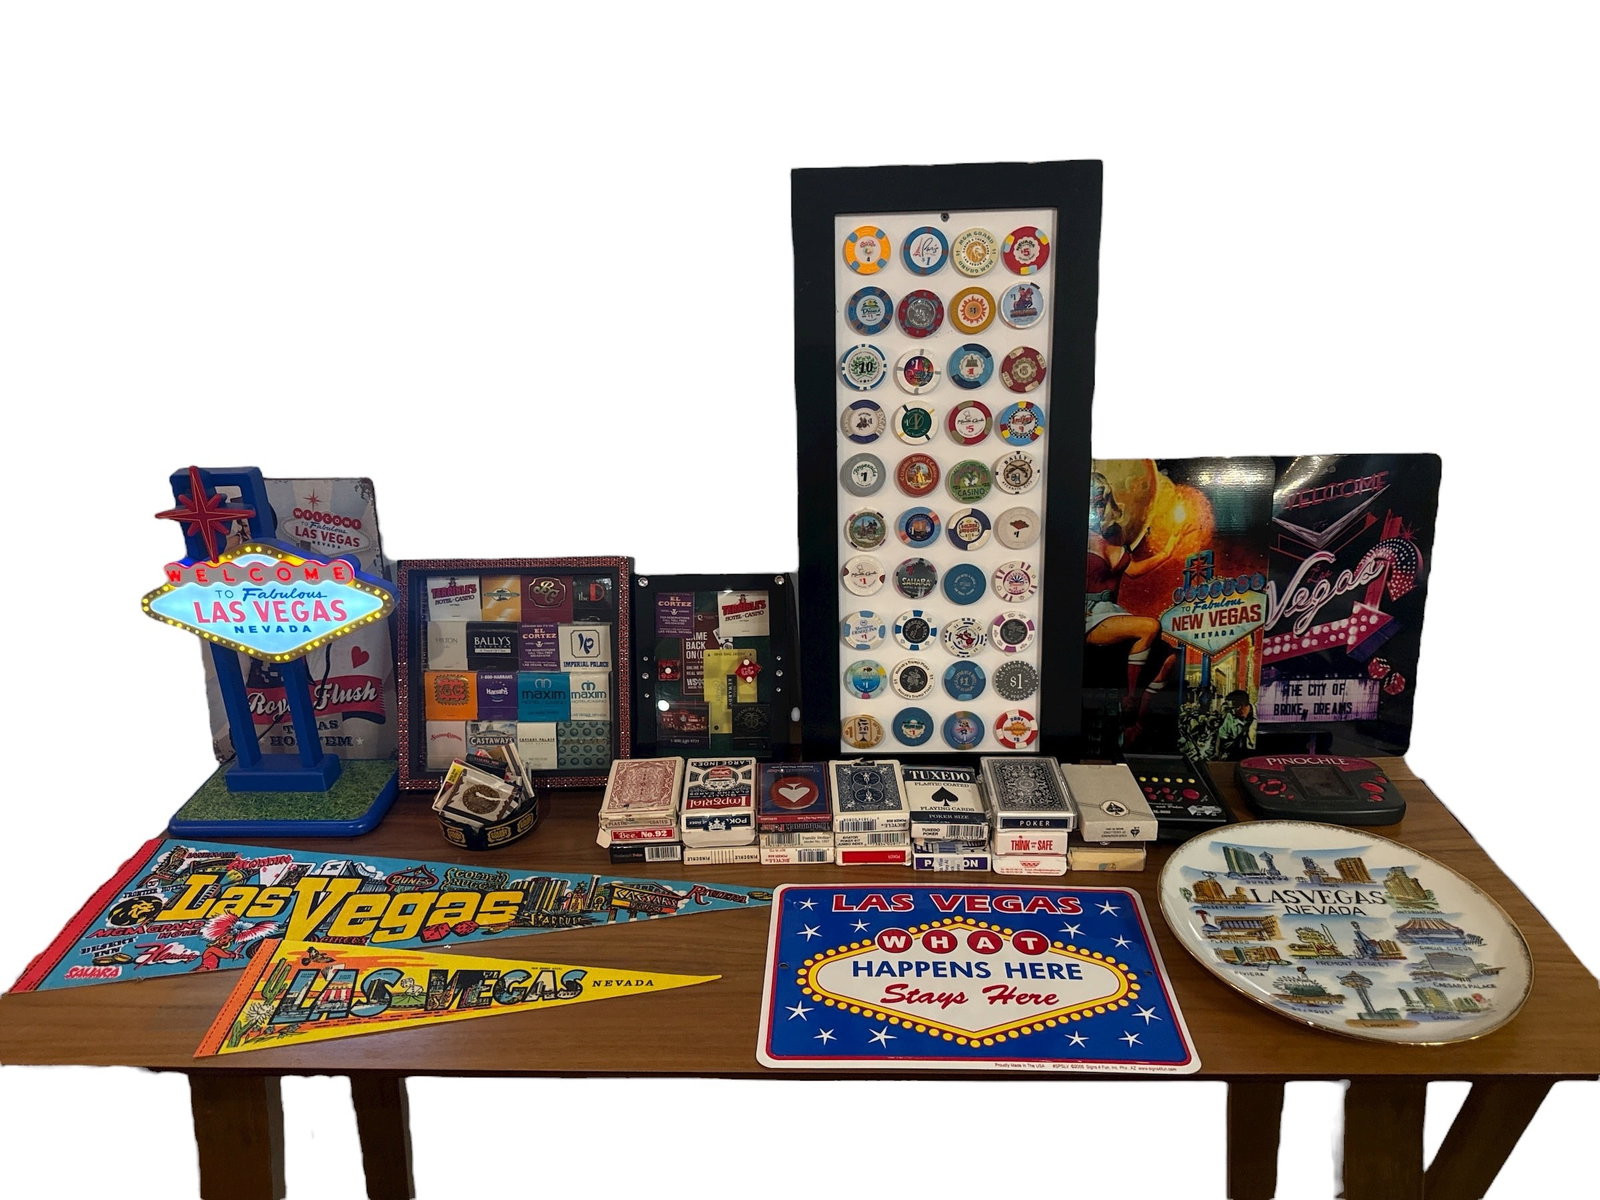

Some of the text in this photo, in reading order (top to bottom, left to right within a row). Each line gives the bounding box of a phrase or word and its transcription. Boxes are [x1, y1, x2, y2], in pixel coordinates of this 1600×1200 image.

[958, 488, 986, 496] CASINO
[293, 507, 362, 530] WELCOME
[295, 525, 360, 548] LAS VEGAS
[312, 540, 341, 550] NEVADA
[166, 566, 346, 583] WELCOME
[215, 588, 328, 602] TO Fabulous
[1265, 551, 1385, 636] Vegas
[193, 600, 348, 624] LAS VEGAS
[1192, 598, 1246, 613] Fabulous
[744, 610, 764, 618] CASINO
[1172, 604, 1262, 632] NEW VEGAS
[234, 625, 312, 634] NEVADA
[1194, 629, 1235, 639] NEVADA
[474, 636, 512, 646] BALLY'S
[686, 641, 706, 650] BACK
[1010, 674, 1023, 690] $1
[313, 681, 378, 710] Flush
[486, 687, 508, 696] Harrah's
[522, 690, 566, 700] maxim
[571, 690, 606, 699] maxim
[1308, 683, 1327, 696] CITY
[1332, 683, 1346, 696] OF
[1314, 702, 1352, 715] DREAMS
[283, 720, 339, 736] TAS
[470, 736, 515, 746] CASTAWAYS
[1266, 756, 1350, 766] PINOCHLE
[909, 770, 970, 781] TUXEDO
[1010, 840, 1054, 850] THINK SAFE
[454, 870, 504, 882] GOLDEN
[123, 888, 158, 898] FRONTIER
[155, 872, 524, 943] Las Vegas
[831, 894, 1084, 916] LAS VEGAS
[1284, 905, 1367, 916] NEVADA
[88, 920, 206, 938] MGM GRAND
[158, 929, 202, 940] HOTEL
[882, 934, 1044, 950] WHAT
[94, 946, 122, 957] INN
[135, 943, 200, 970] Flamingo
[64, 966, 122, 980] SAHARA
[852, 960, 1083, 981] HAPPENS HERE
[268, 968, 404, 1026] LAS
[424, 968, 588, 1010] VEGAS
[592, 979, 655, 988] NEVADA
[880, 983, 1061, 1008] Stays Here
